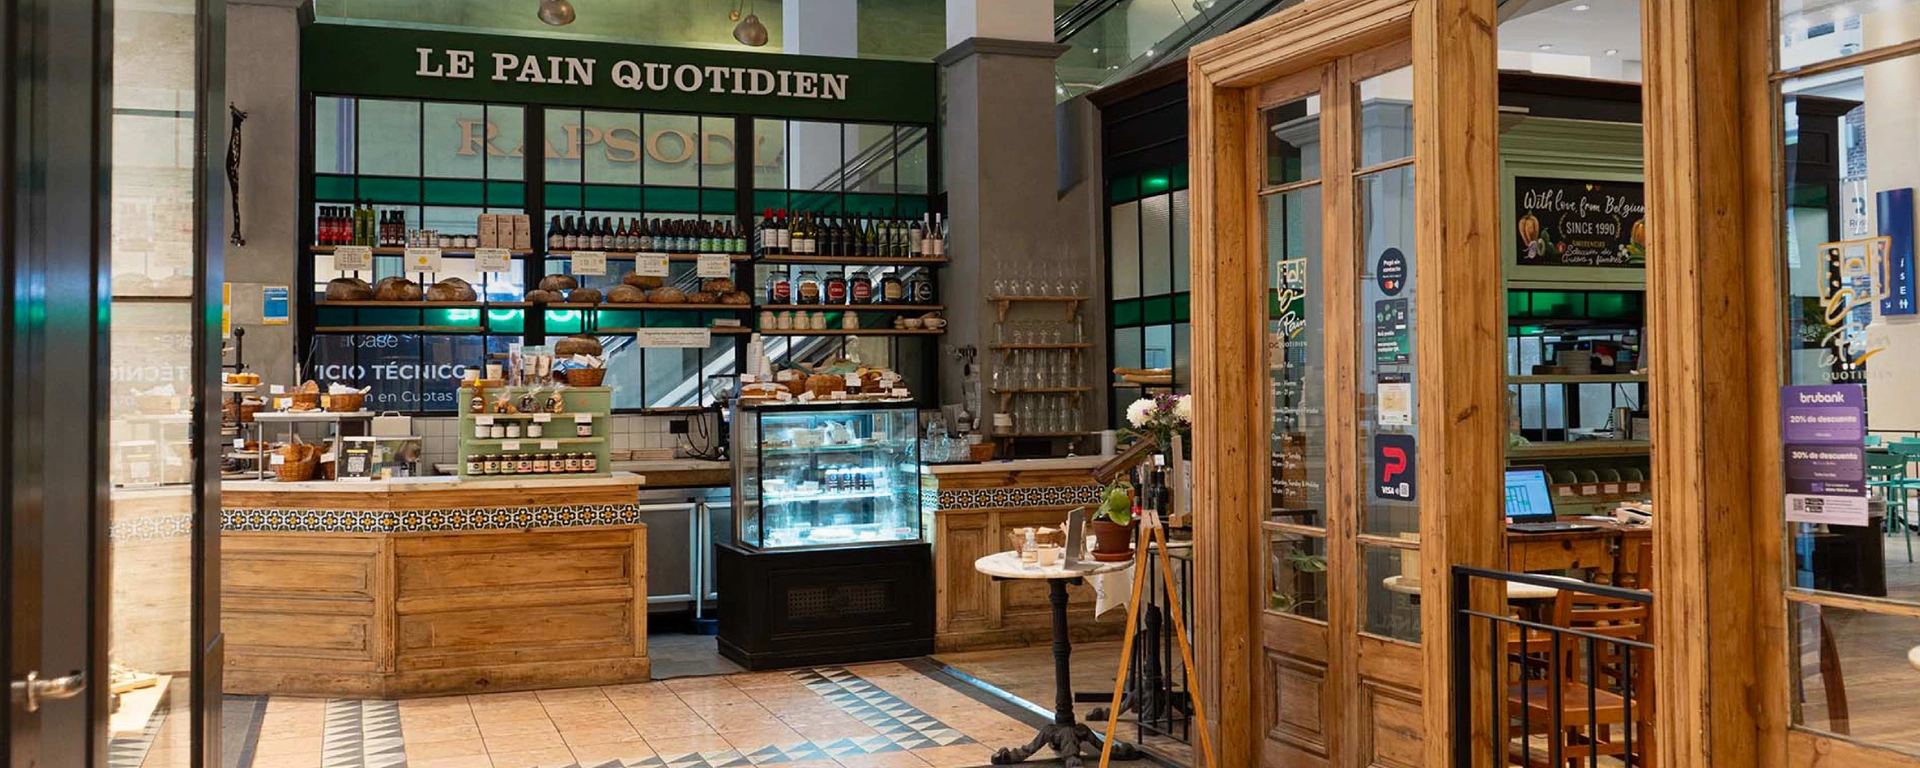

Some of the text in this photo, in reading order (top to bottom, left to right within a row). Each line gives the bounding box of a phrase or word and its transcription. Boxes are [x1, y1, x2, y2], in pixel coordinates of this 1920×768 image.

[416, 47, 849, 100] LE PAIN QUOTIDIEN
[1523, 189, 1552, 212] With
[1579, 196, 1601, 218] from
[1566, 222, 1615, 236] SINCE 1990
[315, 360, 465, 380] ICIO TÉCNICO
[378, 392, 397, 402] en
[1800, 391, 1845, 403] brubank
[1790, 415, 1807, 423] 20%
[1817, 415, 1857, 423] descuento
[1819, 452, 1859, 460] descuento
[1381, 485, 1394, 495] VISA
